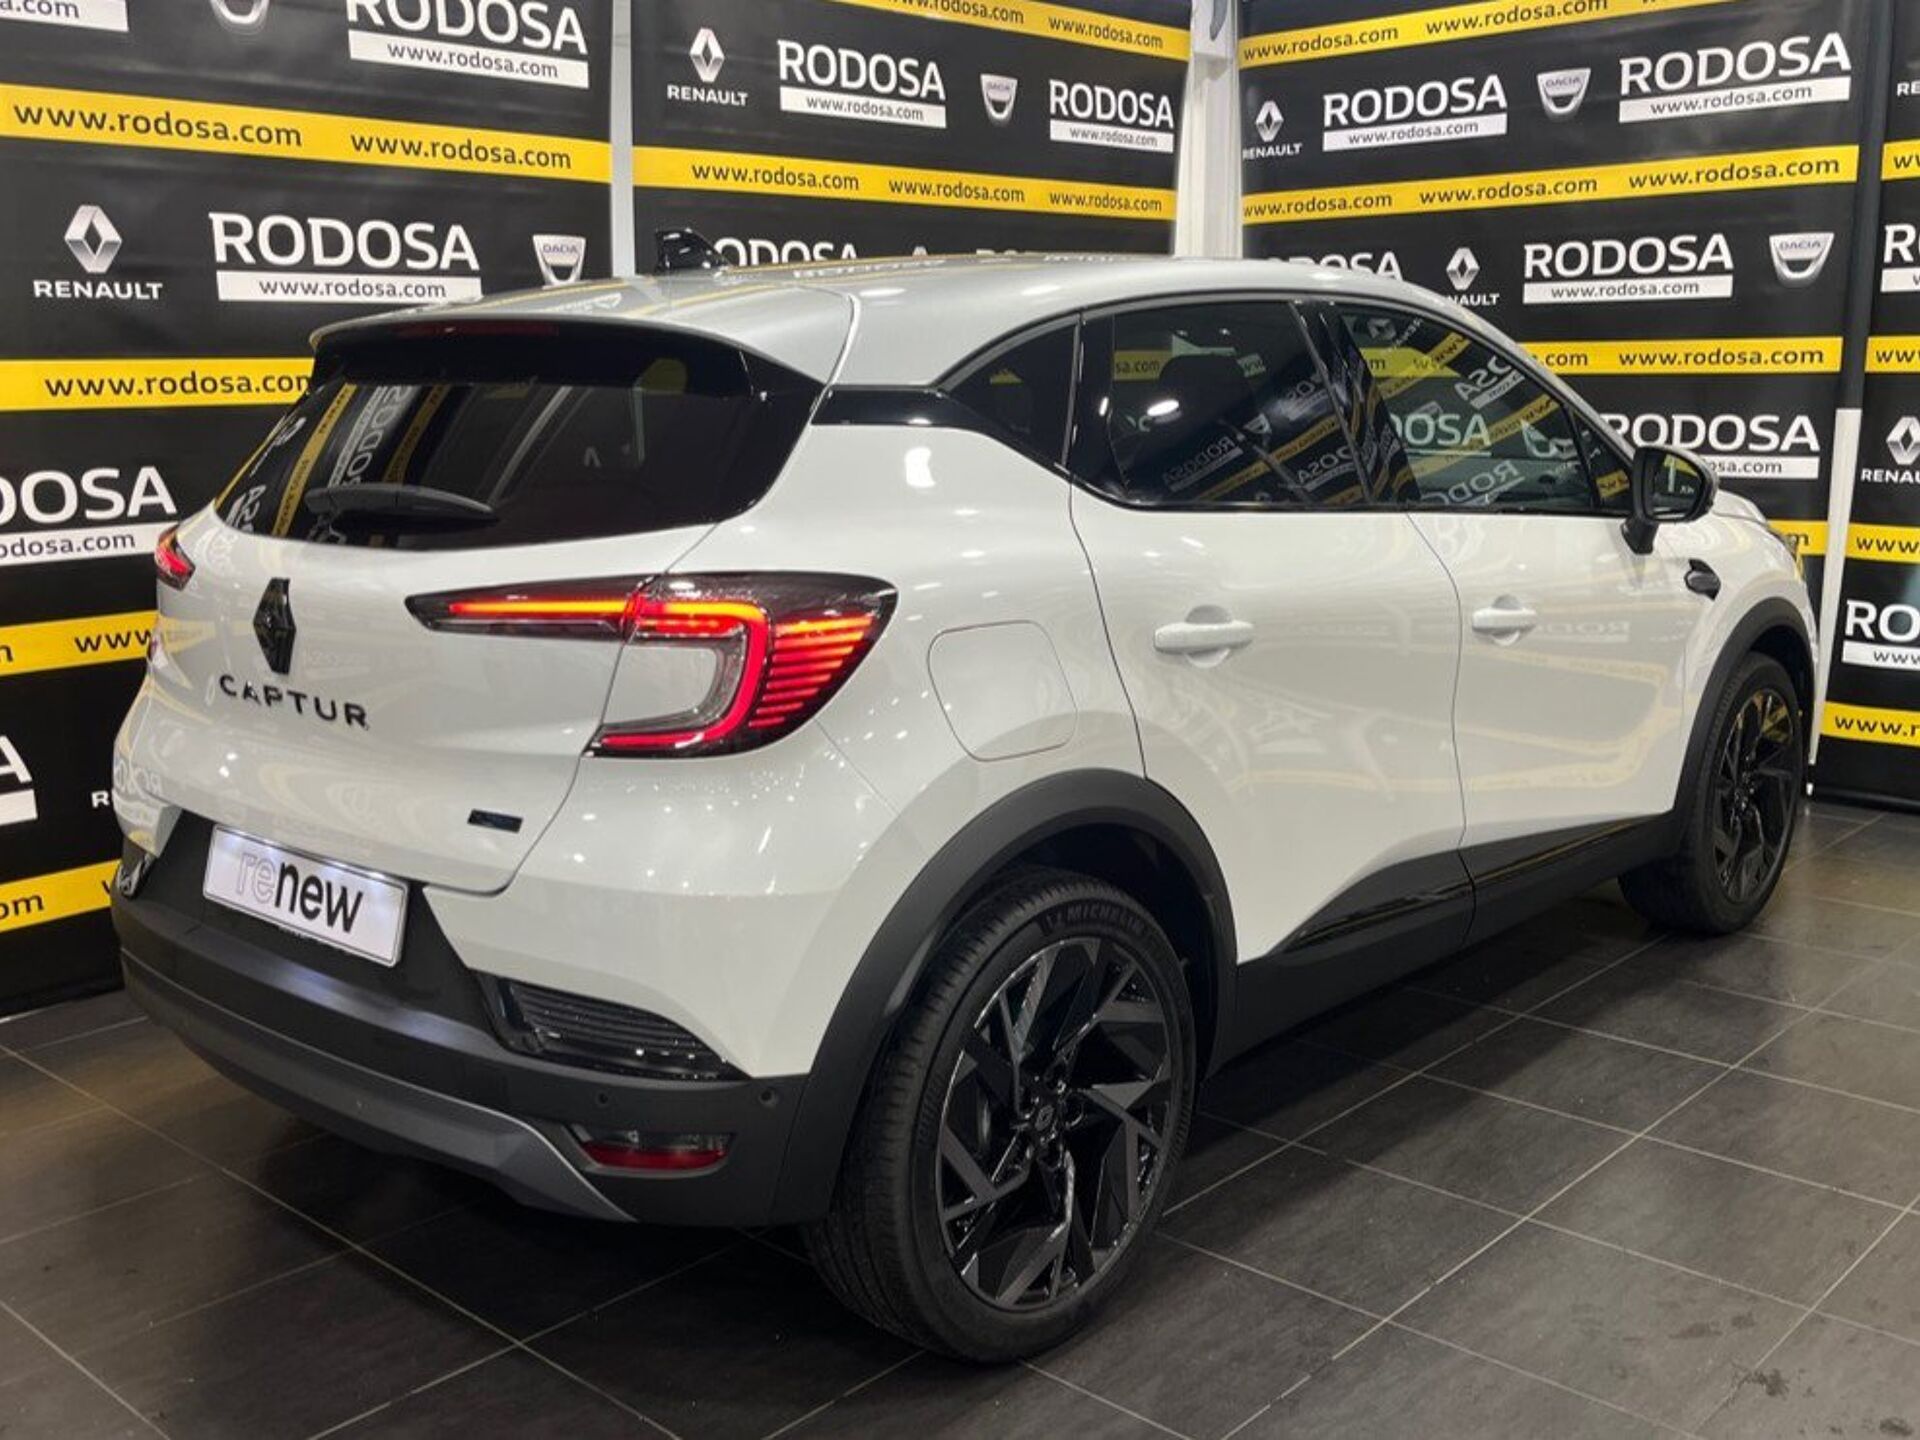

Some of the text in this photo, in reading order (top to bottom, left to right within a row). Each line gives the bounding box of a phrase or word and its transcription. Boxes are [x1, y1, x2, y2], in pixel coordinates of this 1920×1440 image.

[1048, 15, 1164, 48] www.rodosa.com
[1243, 25, 1399, 61] www.rodosa.com
[387, 43, 559, 78] www.rodosa.com
[776, 39, 947, 101] RODOSA
[1619, 32, 1852, 96] RODOSA
[666, 84, 749, 106] RENAULT
[806, 94, 924, 121] www.rodosa.com
[1049, 78, 1176, 129] RODOSA
[1323, 74, 1508, 127] RODOSA
[1649, 85, 1813, 116] www.rodosa.com
[14, 104, 303, 146] www.rodosa.com
[1069, 126, 1158, 148] www.rodosa.com
[1349, 120, 1480, 145] www.rodosa.com
[350, 133, 572, 169] www.rodosa.com
[691, 164, 860, 191] www.rodosa.com
[1628, 156, 1840, 190] www.rodosa.com
[888, 178, 1025, 203] www.rodosa.com
[1050, 191, 1163, 212] www.rodosa.com
[1242, 192, 1393, 217] www.rodosa.com
[1419, 176, 1598, 205] www.rodosa.com
[208, 211, 481, 271] RODOSA
[1523, 233, 1734, 279] RODOSA
[1778, 239, 1822, 251] DACIA
[33, 280, 163, 300] RENAULT
[259, 277, 447, 298] www.rodosa.com
[1551, 281, 1700, 299] www.rodosa.com
[1619, 345, 1825, 367] www.rodosa.com
[1600, 413, 1821, 452] RODOSA
[219, 674, 370, 731] CAPTUR
[235, 852, 364, 933] renew
